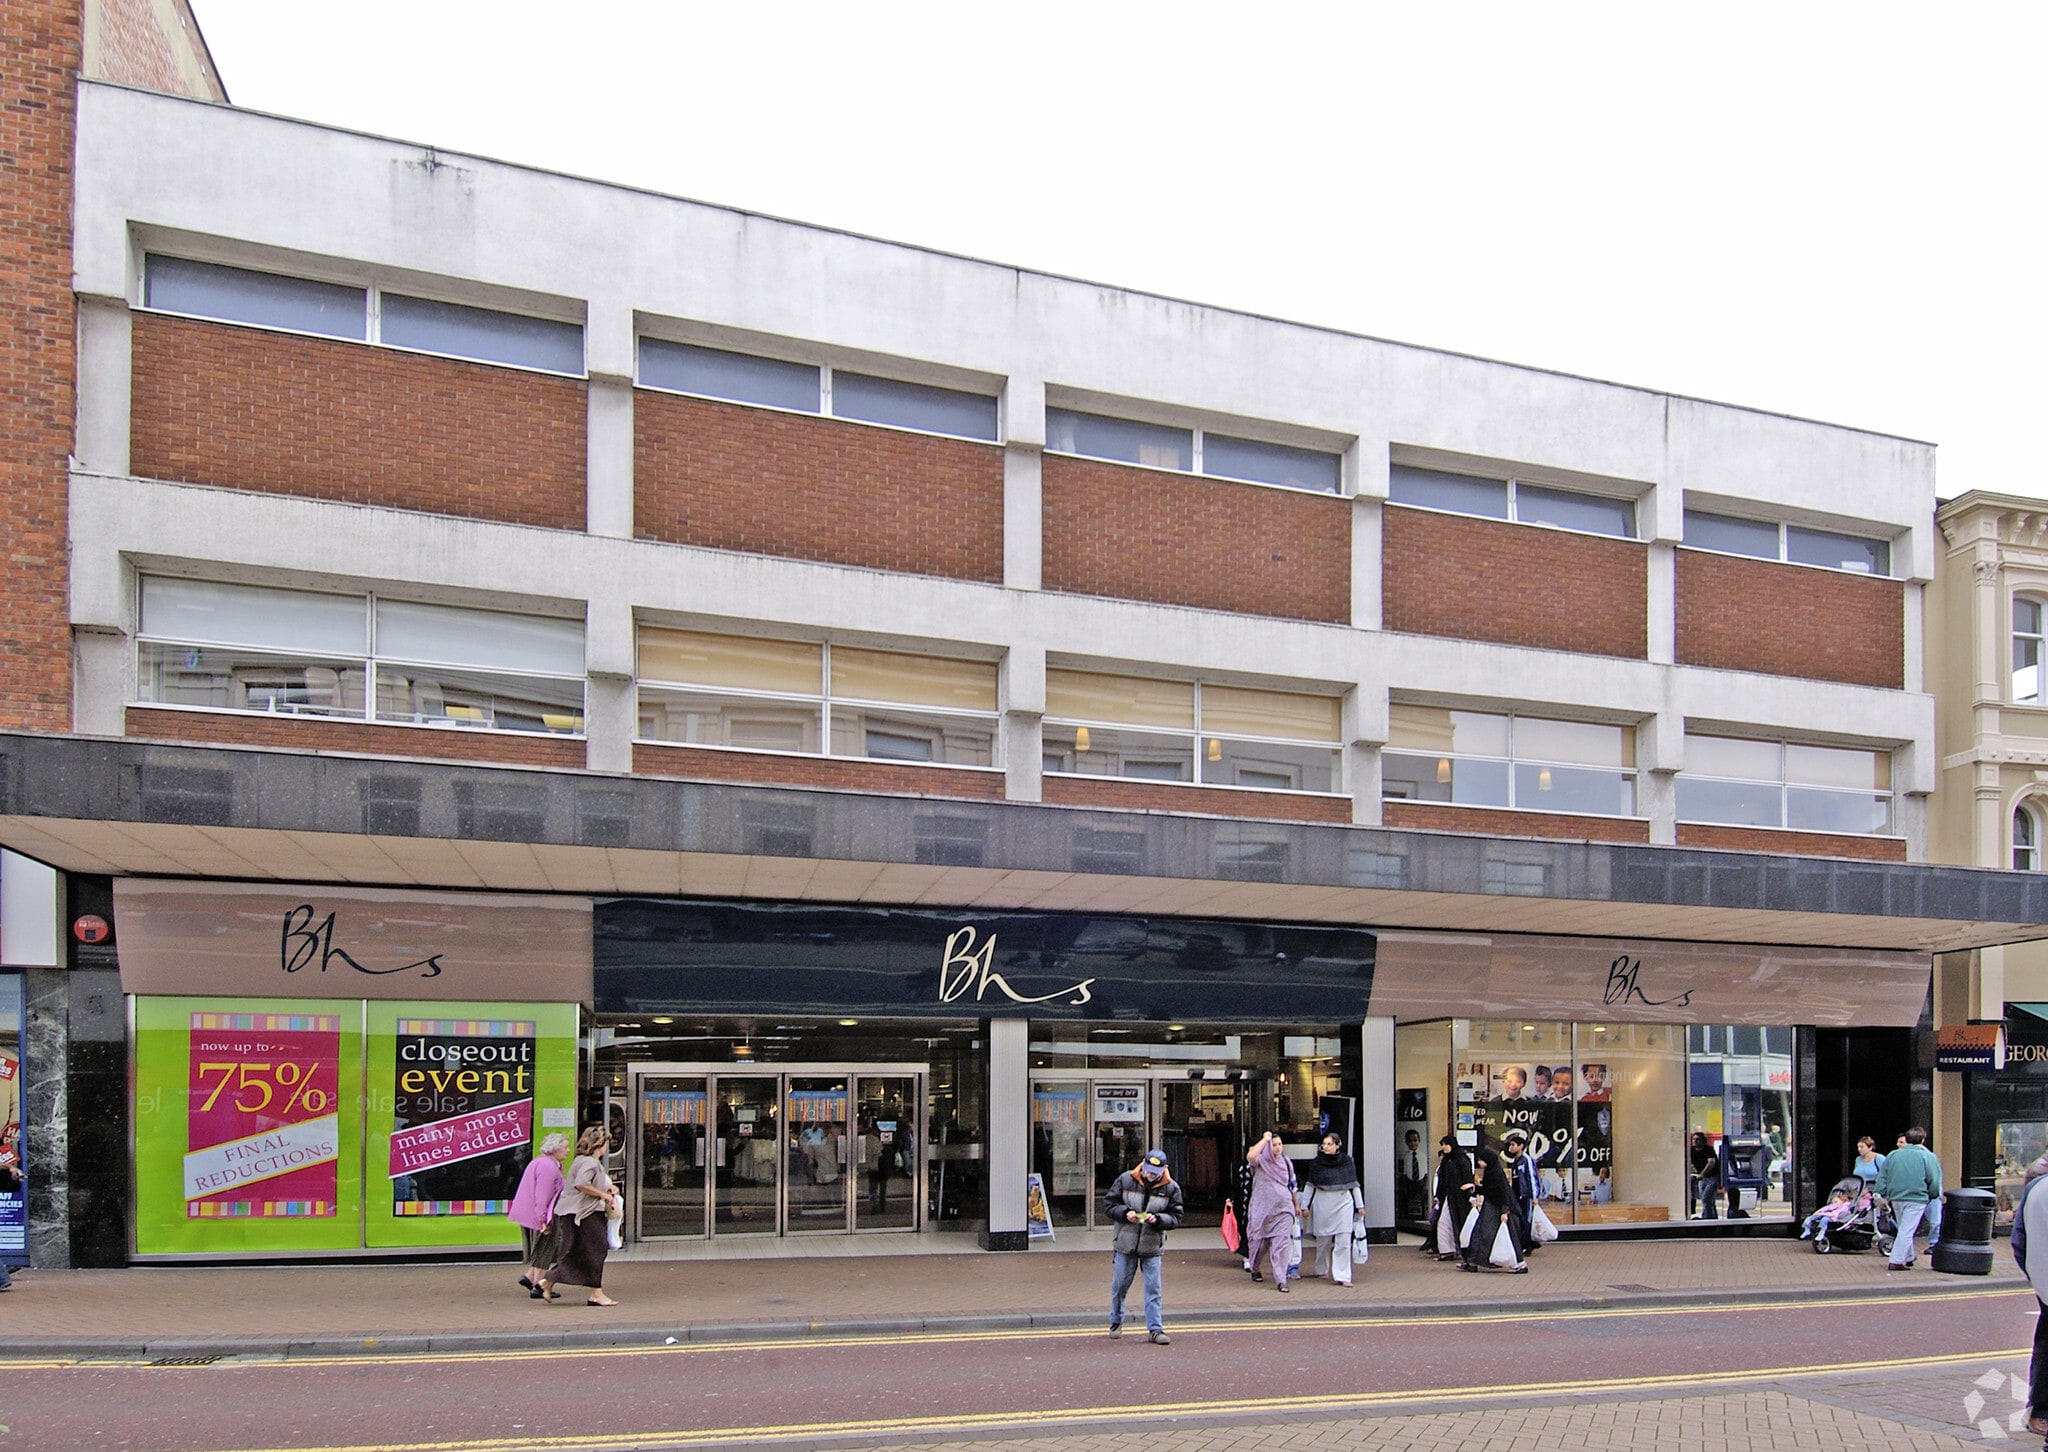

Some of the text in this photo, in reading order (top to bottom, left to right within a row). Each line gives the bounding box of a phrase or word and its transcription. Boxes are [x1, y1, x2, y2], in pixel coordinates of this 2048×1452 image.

[281, 904, 443, 977] Bhs
[939, 925, 1096, 1005] Bhs
[1603, 955, 1694, 1007] Bhs
[201, 1042, 269, 1054] now up to
[401, 1038, 531, 1062] closeout
[2005, 1045, 2048, 1062] GEOR
[199, 1061, 328, 1114] 75%
[401, 1064, 530, 1094] event
[397, 1125, 455, 1150] many
[464, 1110, 518, 1132] more
[1503, 1109, 1539, 1125] NOW
[225, 1136, 291, 1162] FINAL
[401, 1125, 524, 1167] lines added
[1590, 1147, 1611, 1162] OFF
[194, 1142, 333, 1191] REDUCTIONS
